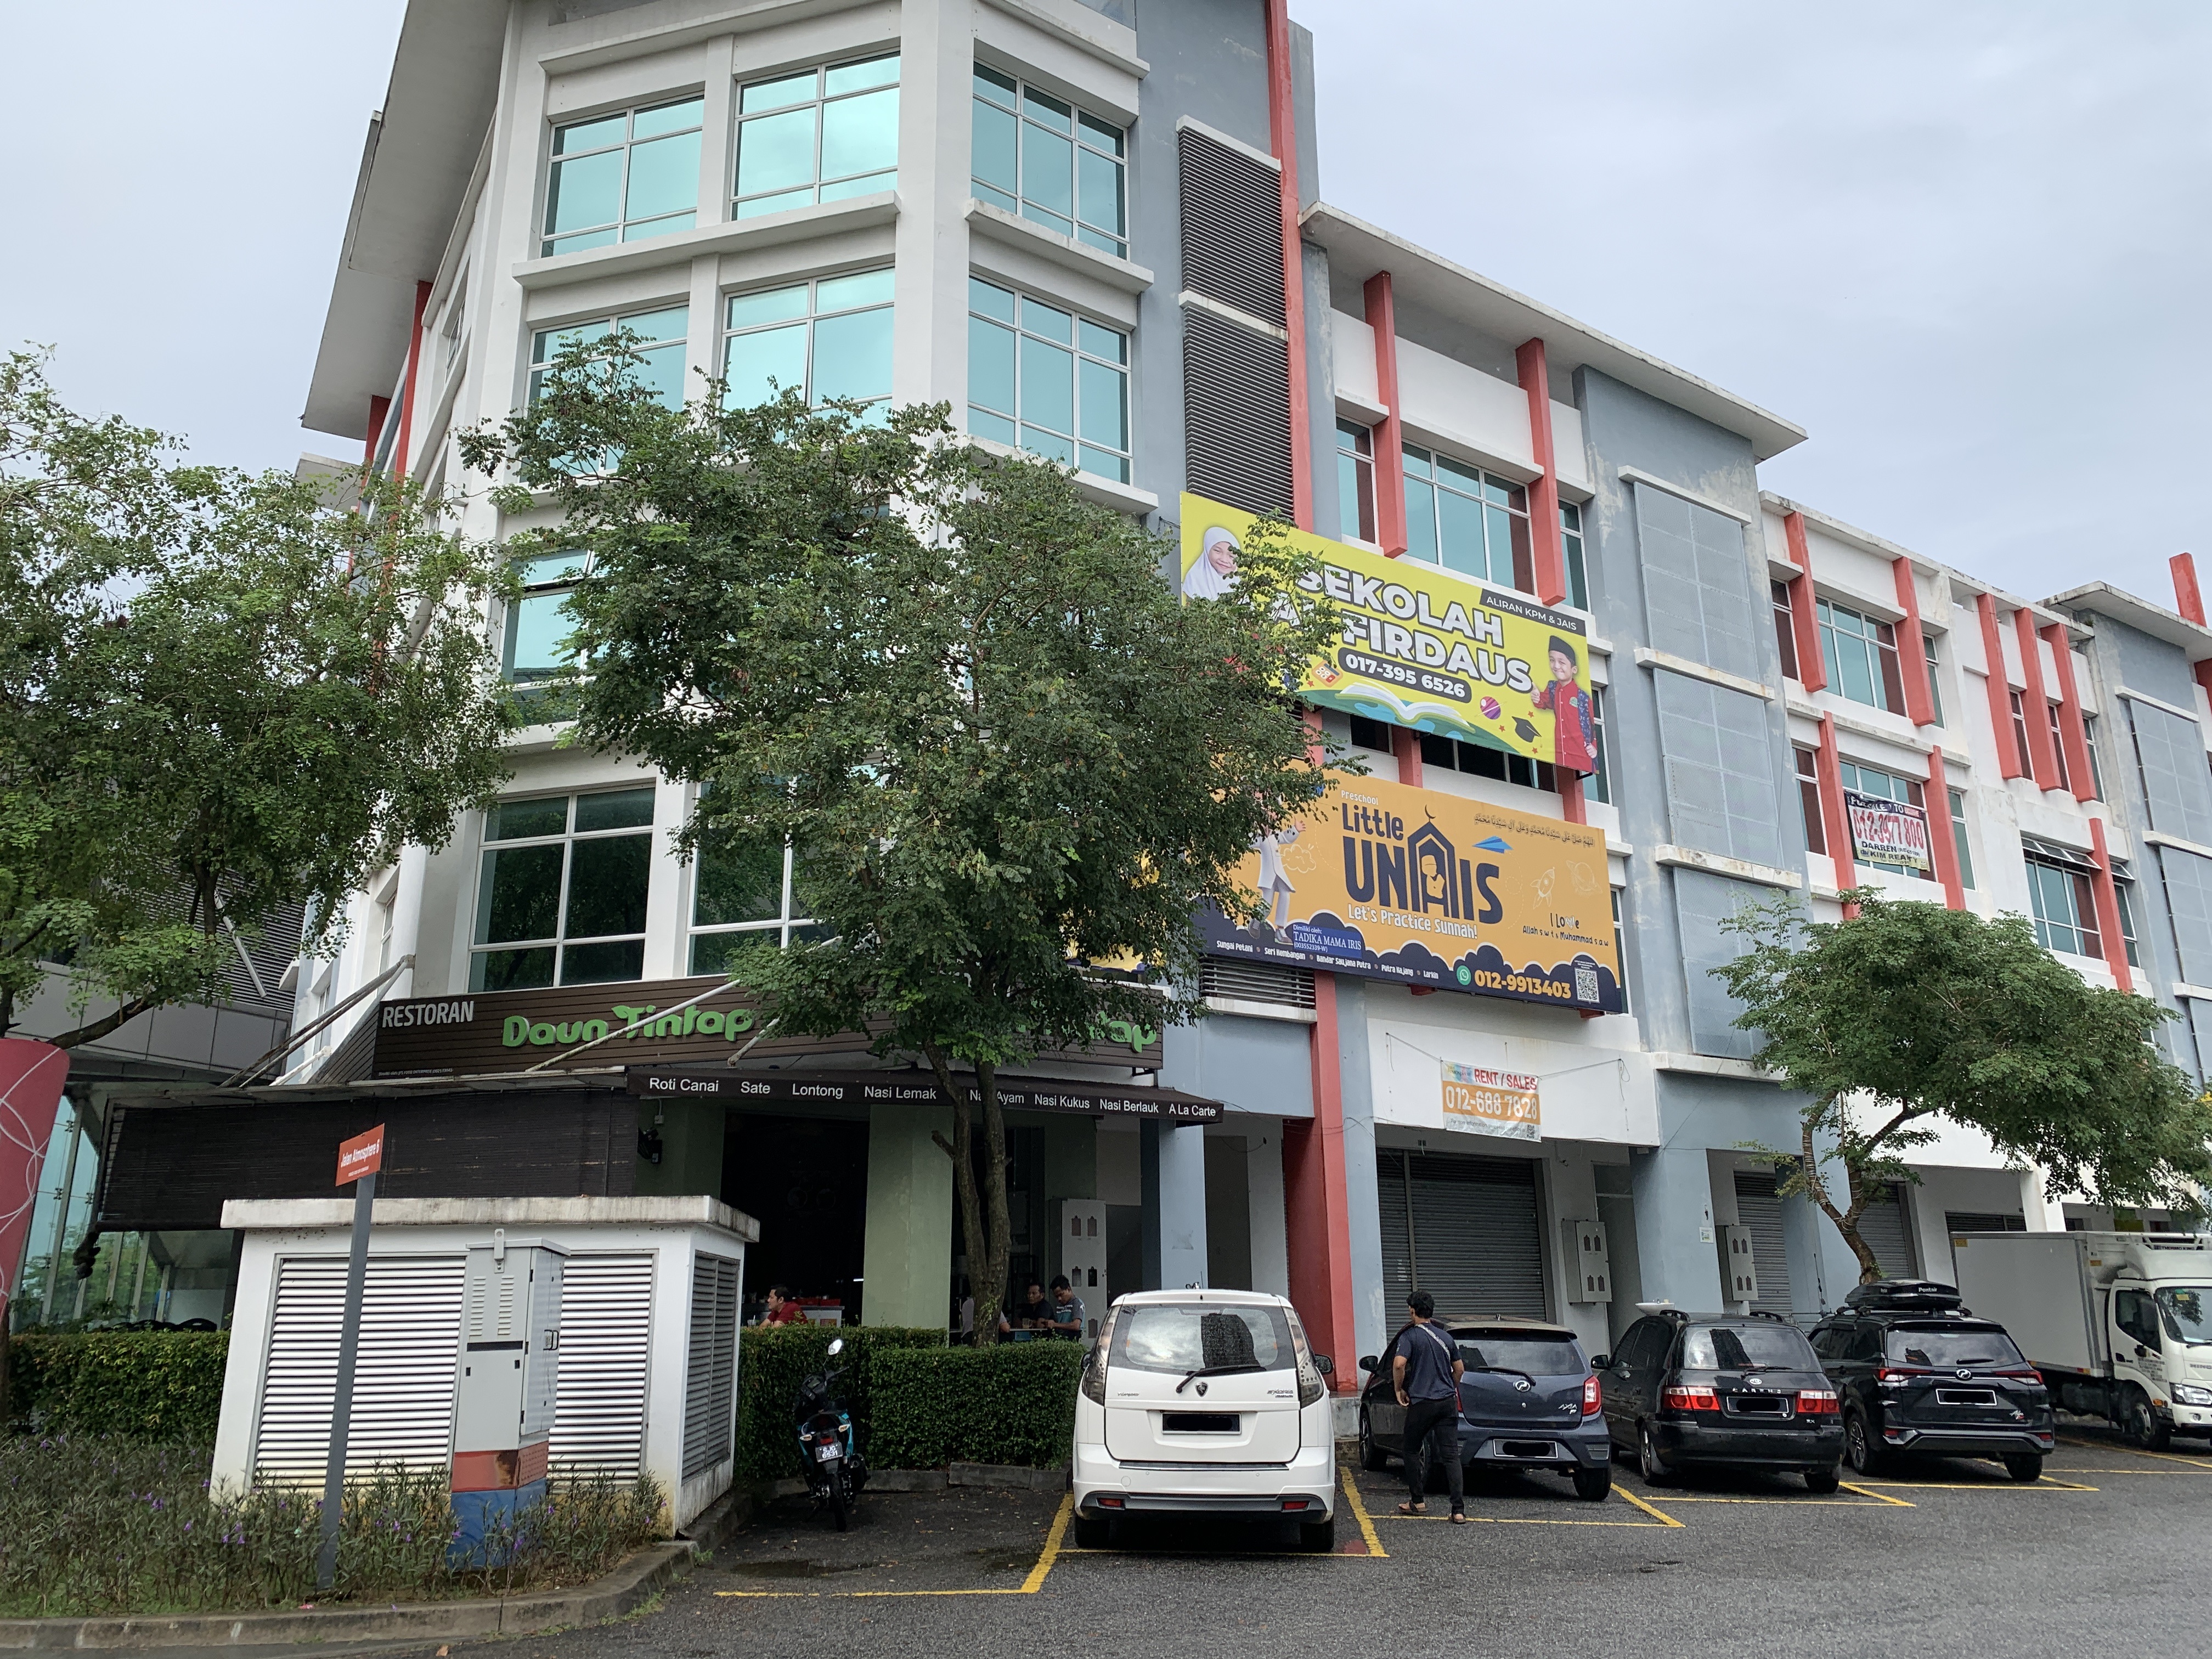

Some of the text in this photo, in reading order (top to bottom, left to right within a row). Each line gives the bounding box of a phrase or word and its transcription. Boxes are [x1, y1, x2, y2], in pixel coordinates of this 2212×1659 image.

[1294, 557, 1504, 648] SEKOLAH
[1486, 596, 1577, 630] ALIRAN KPM & JAIS
[1340, 608, 1533, 693] FIRDAUS
[1345, 654, 1465, 698] 017-395 6526
[1342, 803, 1404, 841] Little
[1895, 803, 1904, 813] TO
[1861, 841, 1897, 853] DARREN
[1904, 817, 1923, 849] 800
[1343, 821, 1503, 924] UNAIS
[1293, 924, 1310, 933] Dimiliki
[1348, 903, 1478, 940] Let's Practice Sunnah!
[1523, 926, 1538, 935] Allah
[1560, 932, 1593, 944] Muhammad
[1550, 912, 1553, 927] I
[1293, 932, 1361, 950] TADIKA MAMA IRIS
[1216, 940, 1234, 950] Sungai
[1235, 943, 1253, 952] Petani
[1276, 949, 1306, 960] Kembangan
[1317, 955, 1334, 964] Bandar
[1335, 957, 1356, 968] Saujana
[1357, 961, 1371, 969] Putra
[1381, 964, 1396, 973] Putra
[1396, 966, 1413, 977] Kajang
[1423, 970, 1438, 979] Larkin
[1474, 969, 1571, 1000] 012-9913403
[382, 1001, 475, 1028] RESTORAN
[501, 1015, 609, 1047] Daun
[1474, 1069, 1537, 1091] RENT / SALES
[649, 1077, 676, 1091] Roti
[680, 1079, 719, 1093] Canai
[741, 1081, 770, 1094] Sate
[792, 1083, 843, 1100] Lontong
[865, 1086, 892, 1098] Nasi
[896, 1087, 937, 1101] Lemak
[997, 1091, 1024, 1105] Ayam
[1035, 1093, 1057, 1106] Nasi
[1059, 1096, 1090, 1109] Kukus
[1099, 1098, 1121, 1111] Nasi
[1124, 1098, 1159, 1114] Berlauk
[1169, 1104, 1176, 1114] A
[1178, 1105, 1189, 1115] La
[1191, 1105, 1216, 1117] Carte
[1446, 1086, 1537, 1120] 012-688 7828
[341, 1149, 352, 1168] Jalan
[352, 1143, 376, 1163] Atmosphere
